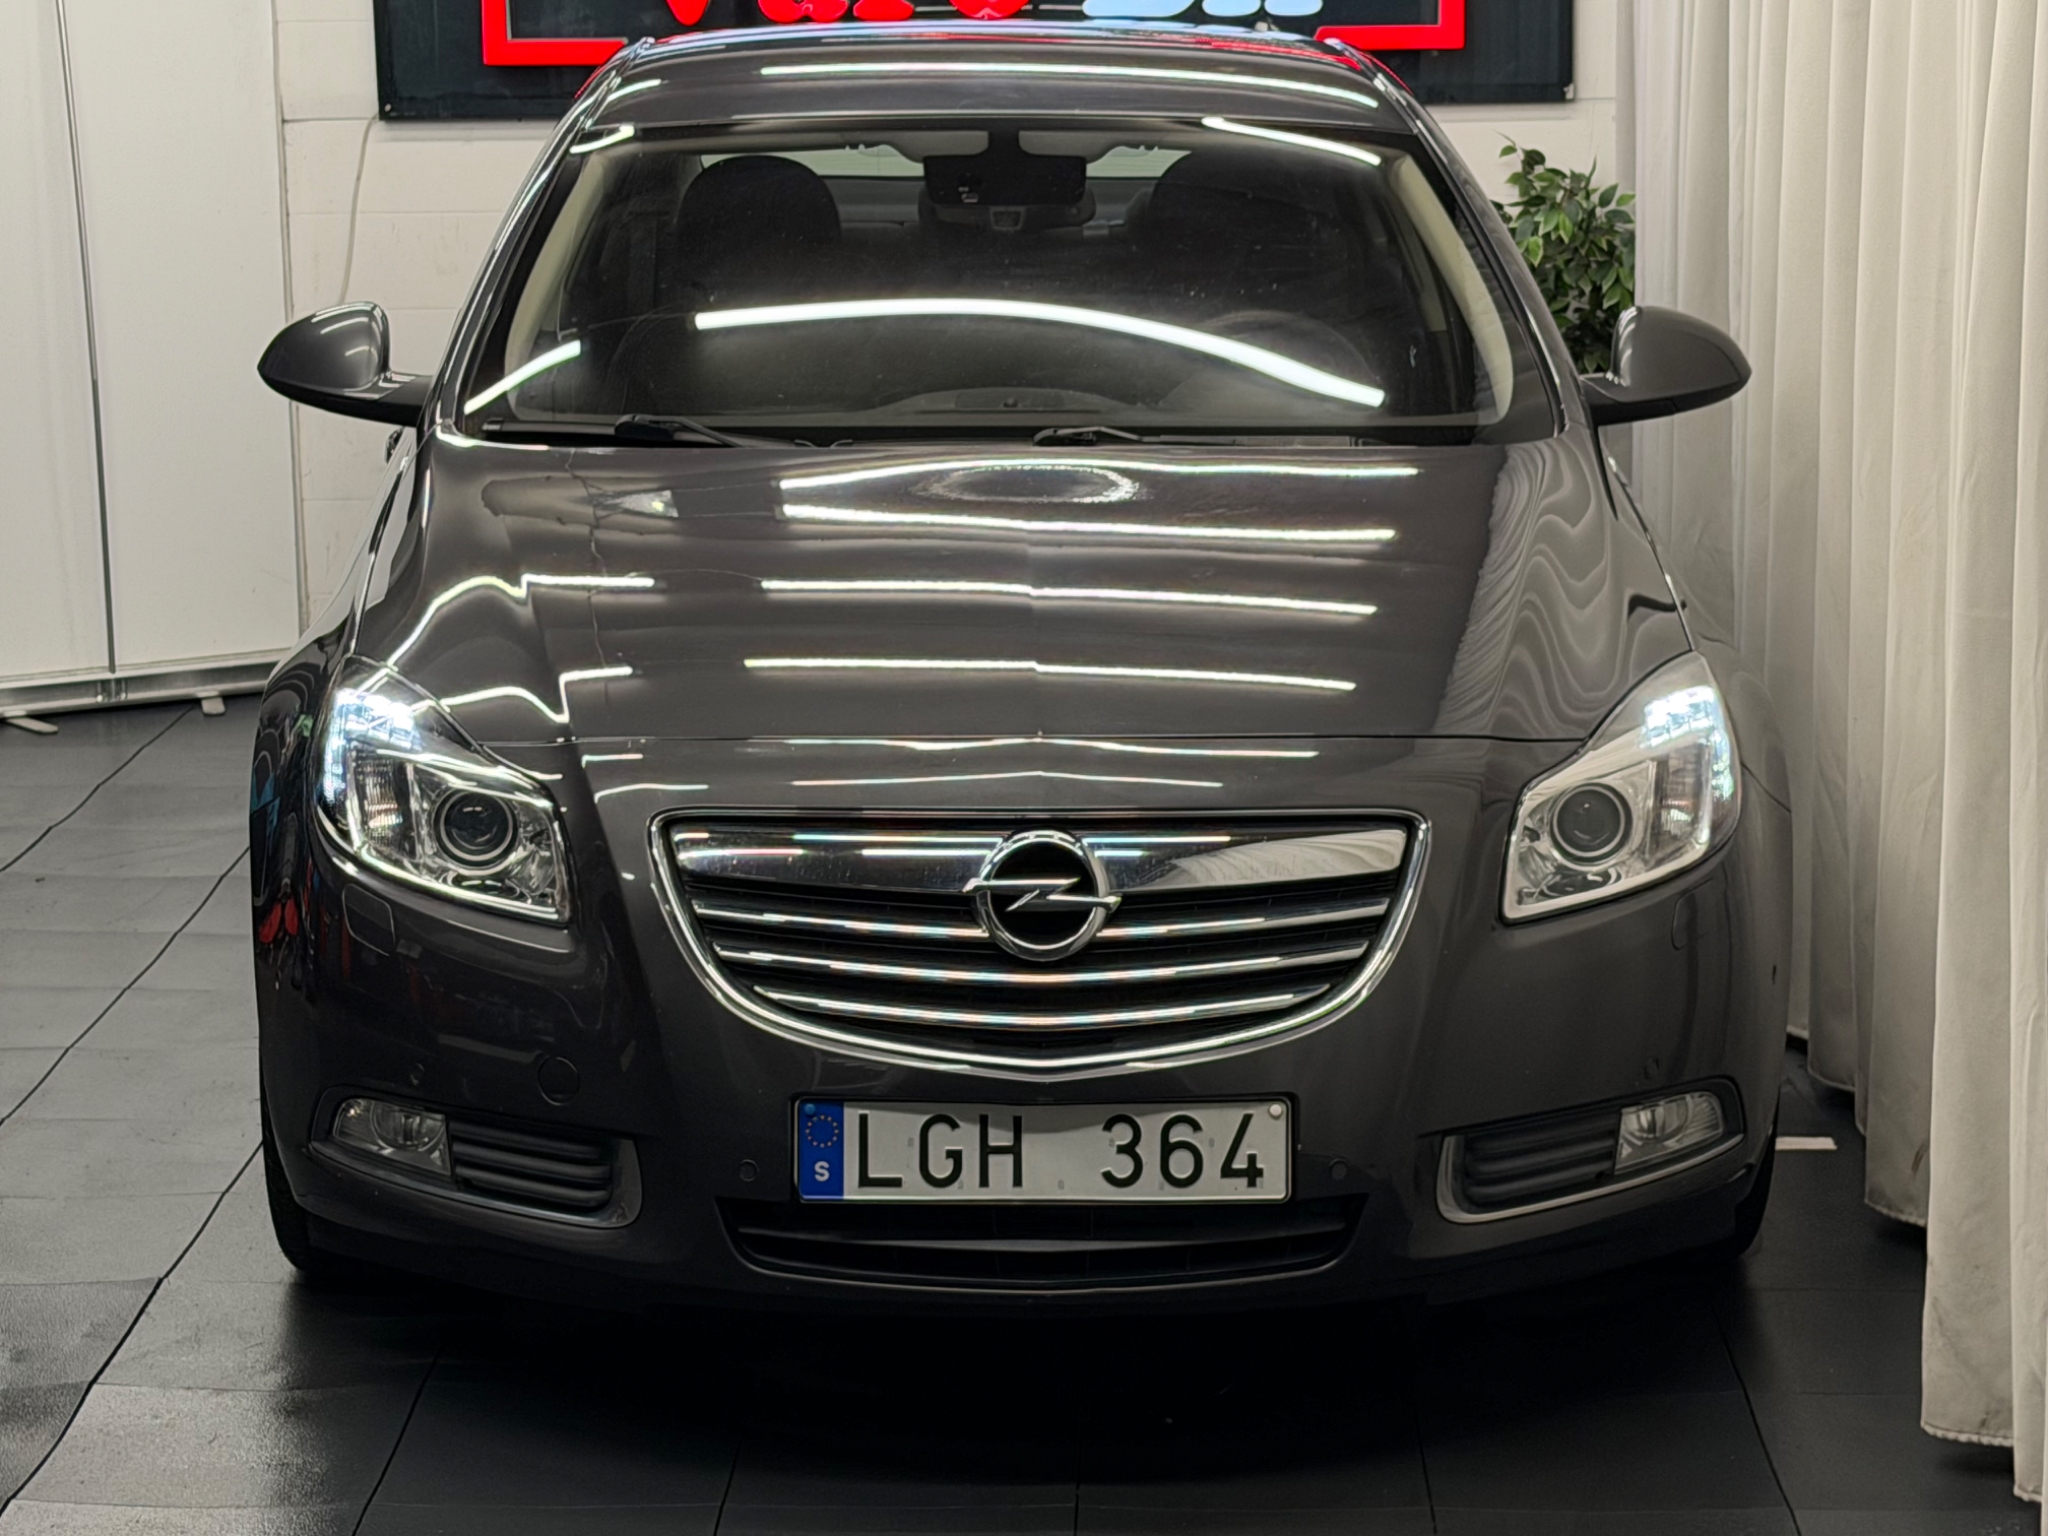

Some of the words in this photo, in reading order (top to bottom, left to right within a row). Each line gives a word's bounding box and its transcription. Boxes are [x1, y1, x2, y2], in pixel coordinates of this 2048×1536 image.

[813, 1160, 830, 1182] S
[857, 1112, 1024, 1188] LGH
[1101, 1112, 1265, 1188] 364
